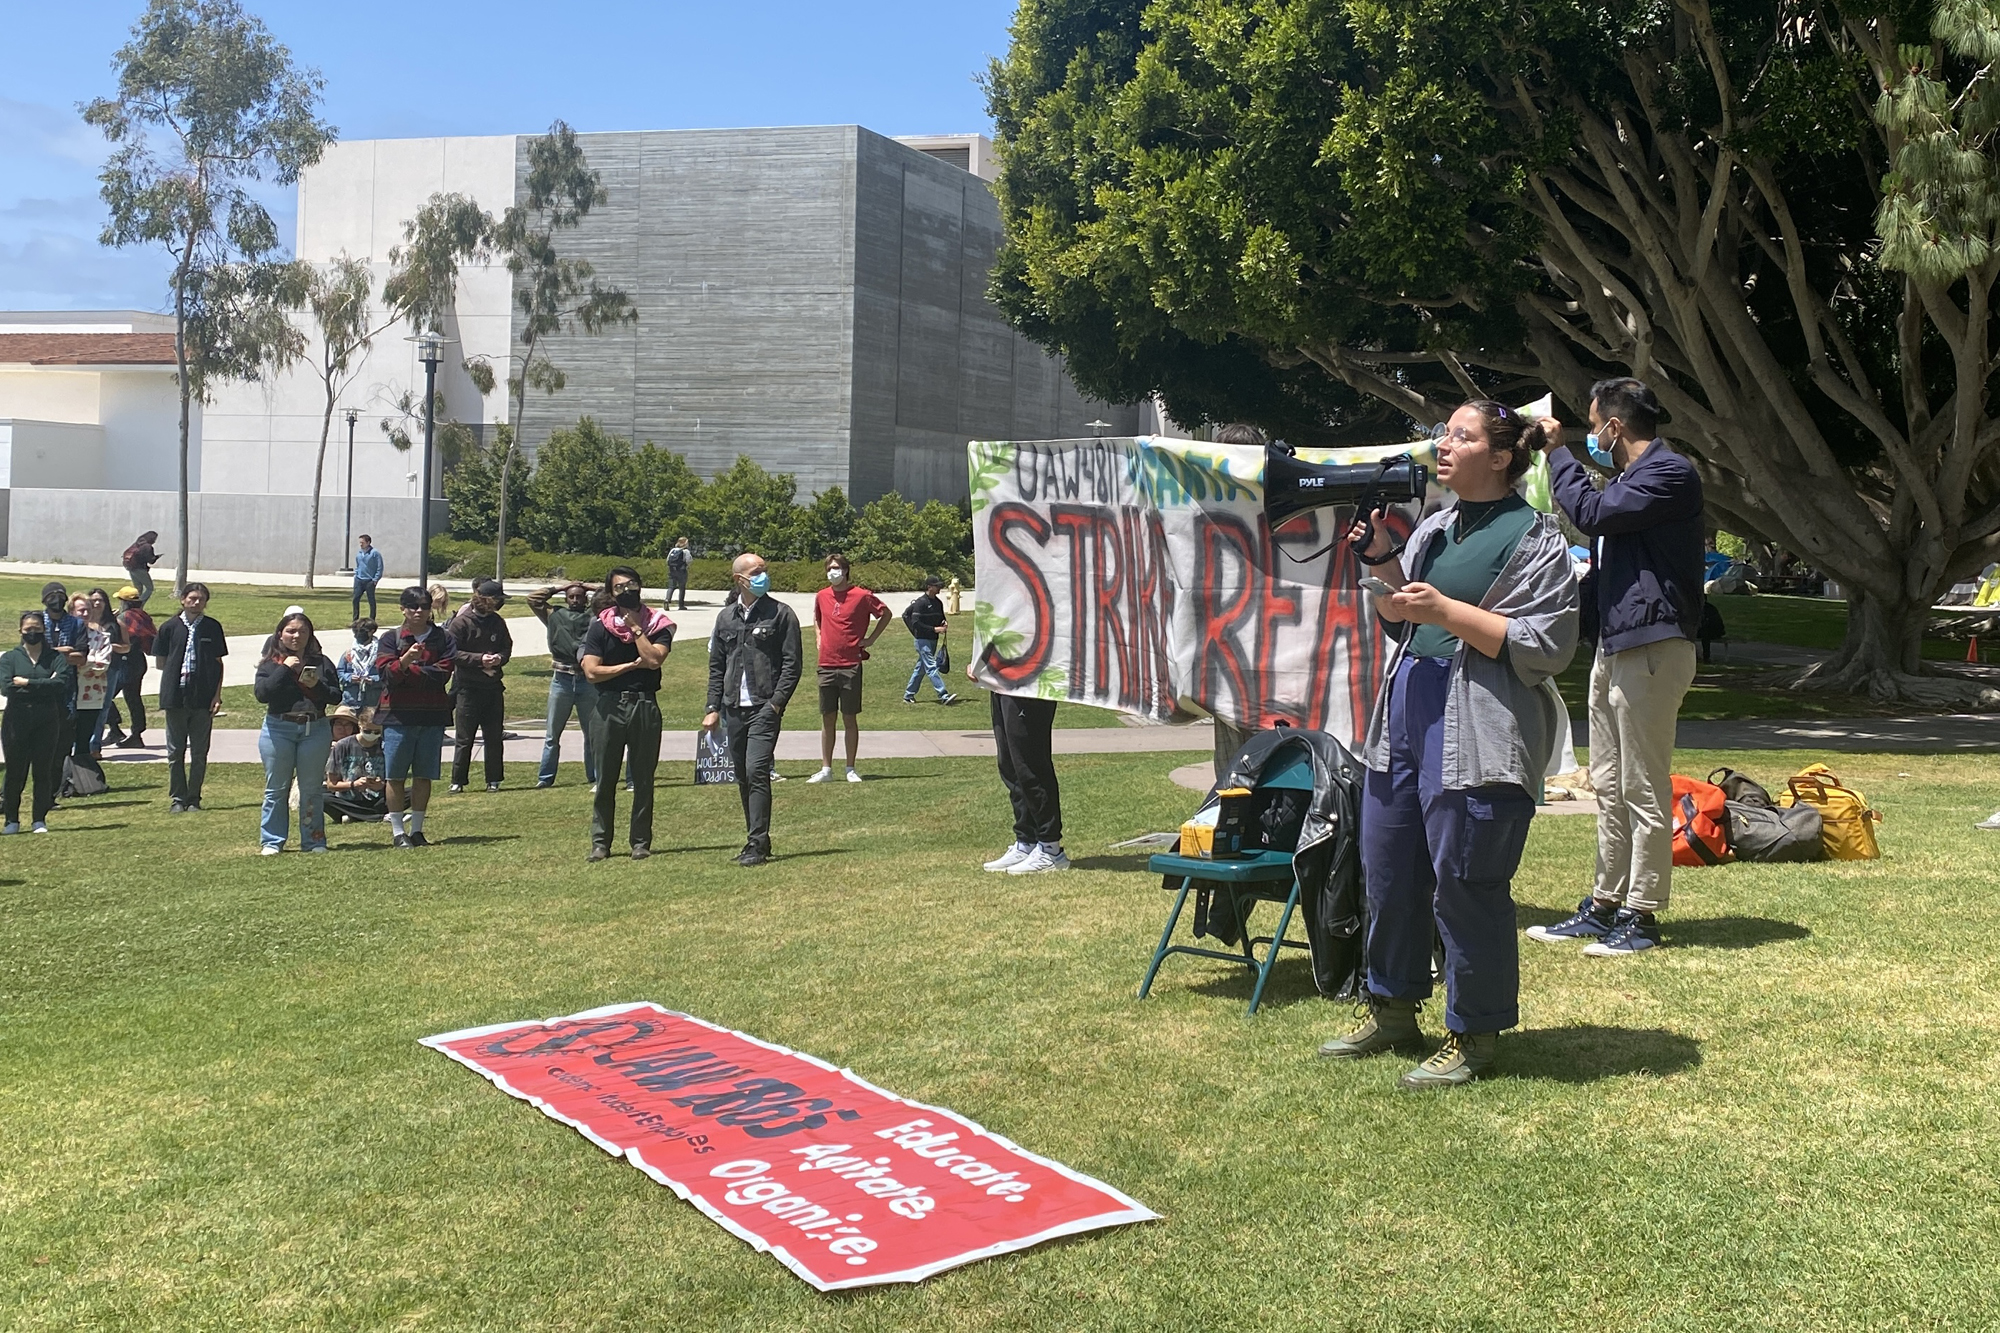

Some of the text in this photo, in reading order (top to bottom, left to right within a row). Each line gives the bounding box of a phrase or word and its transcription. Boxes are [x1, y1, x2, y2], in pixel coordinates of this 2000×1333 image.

[1298, 477, 1326, 488] PYLE
[695, 770, 735, 783] SUPPORT
[789, 1144, 936, 1220] Agitate.
[873, 1118, 1032, 1202] Educate.
[709, 1159, 878, 1266] Organize.
